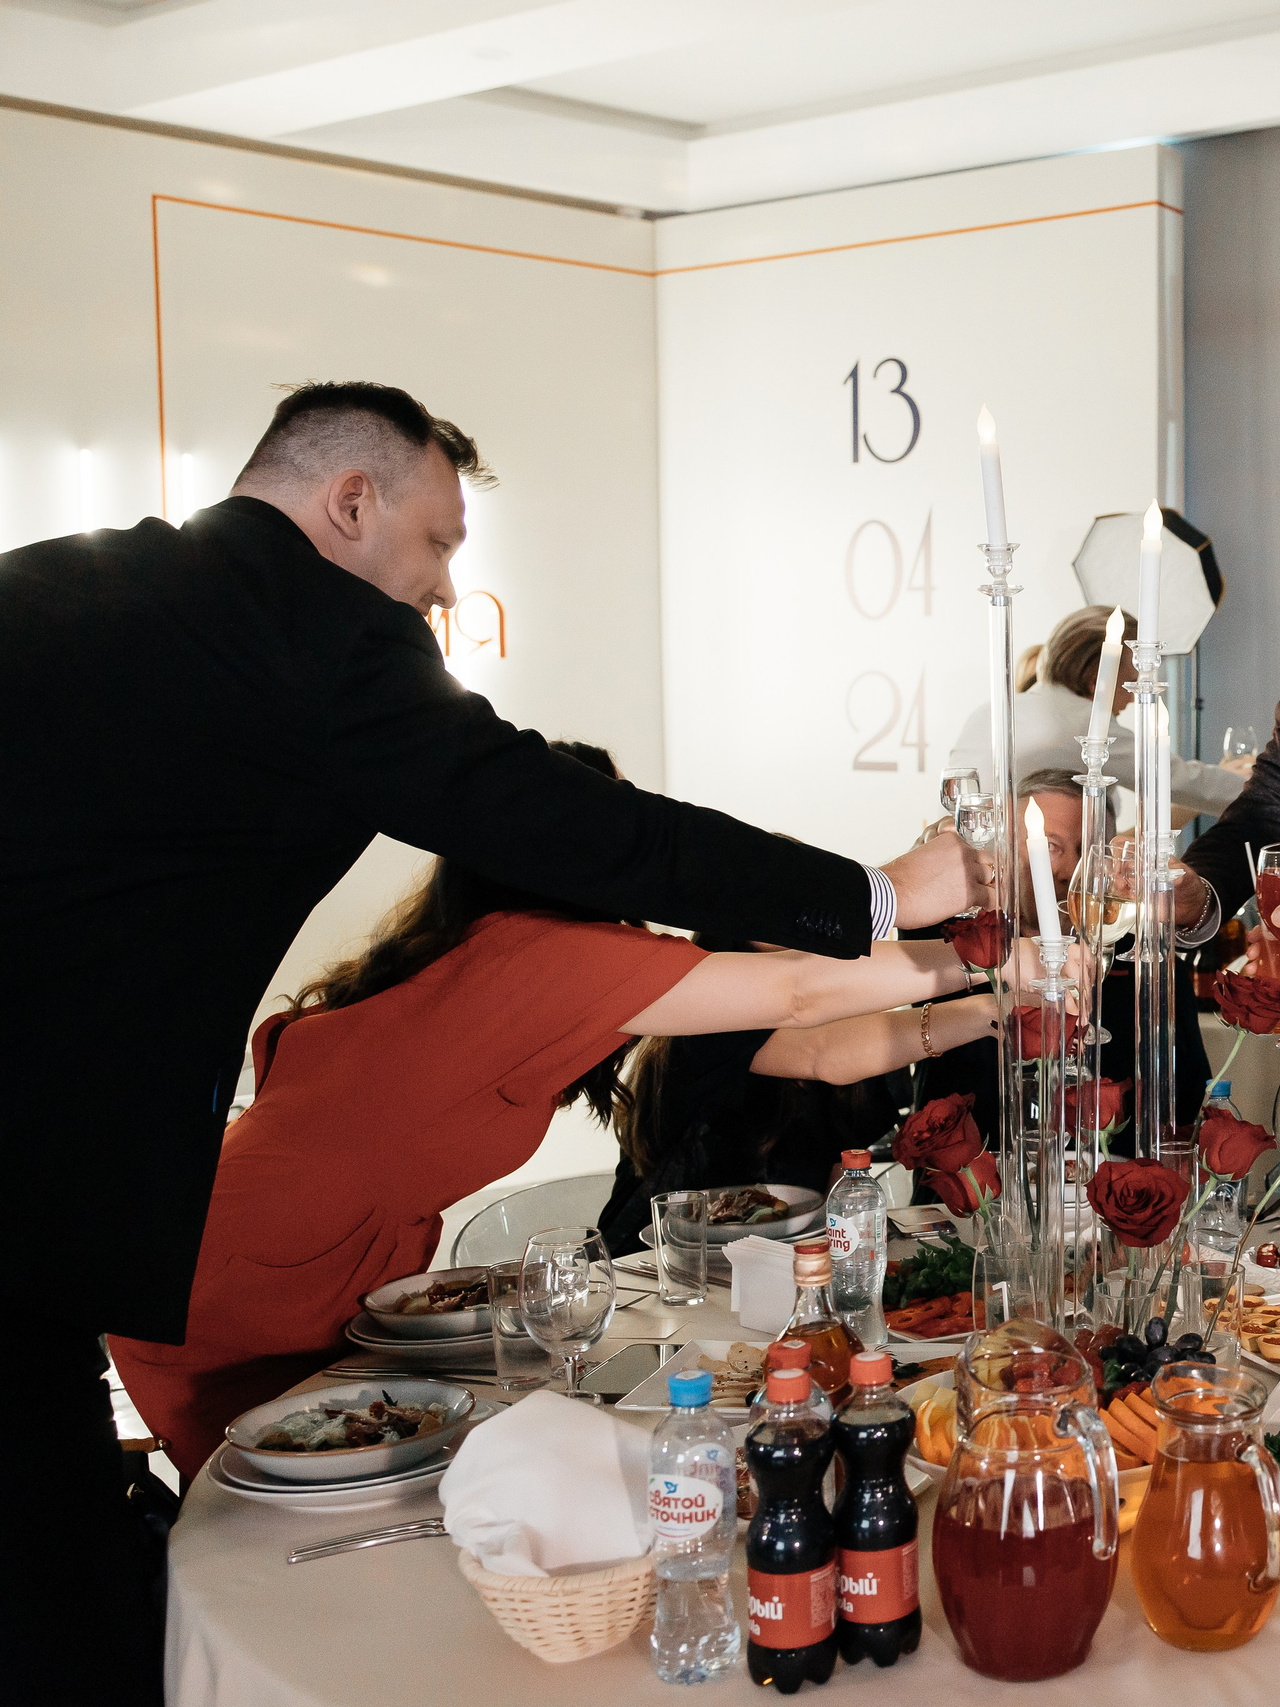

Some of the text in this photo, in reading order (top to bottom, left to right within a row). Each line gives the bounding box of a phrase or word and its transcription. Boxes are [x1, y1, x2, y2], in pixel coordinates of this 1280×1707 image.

[843, 357, 922, 464] 13
[844, 503, 937, 620] 04
[845, 664, 930, 773] 24
[828, 1238, 850, 1252] ring
[748, 1595, 784, 1620] рый
[840, 1572, 878, 1596] рый
